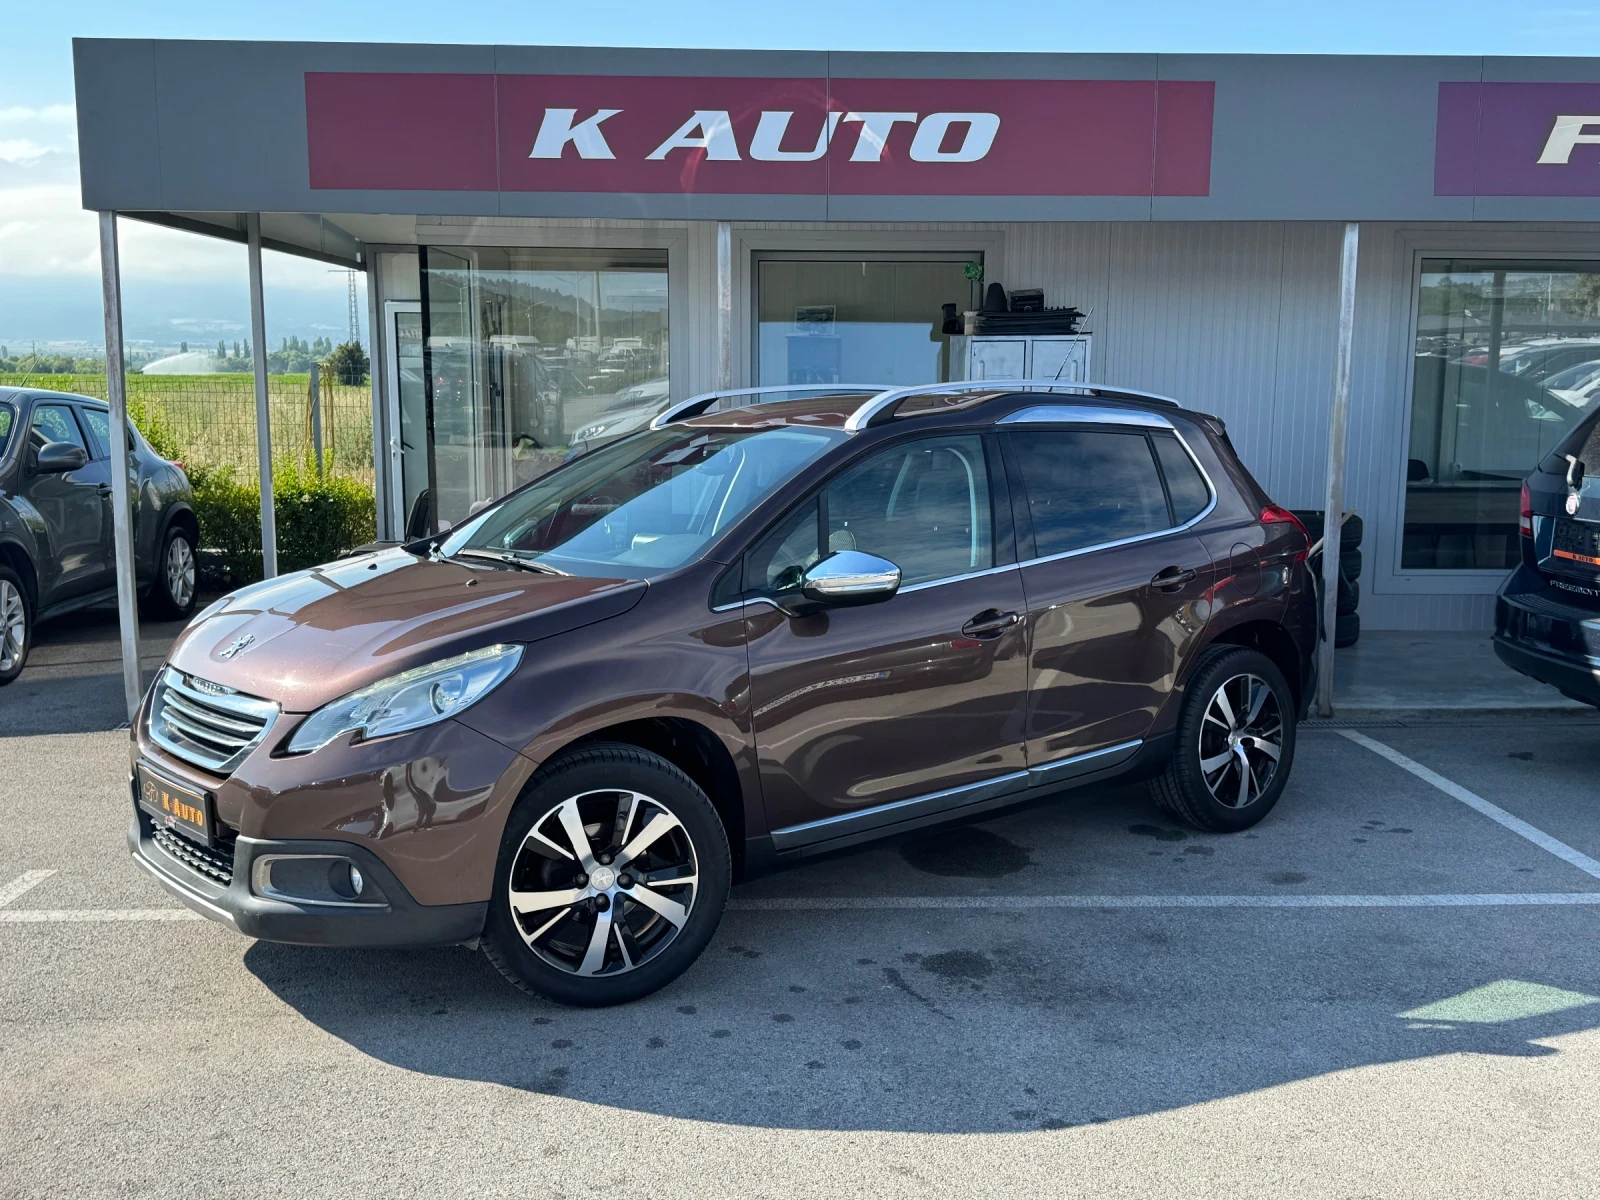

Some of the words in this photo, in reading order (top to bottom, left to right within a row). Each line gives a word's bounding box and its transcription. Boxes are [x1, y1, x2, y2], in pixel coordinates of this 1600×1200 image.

[528, 108, 624, 160] K
[644, 109, 1001, 163] AUTO
[171, 798, 203, 826] AUTO
